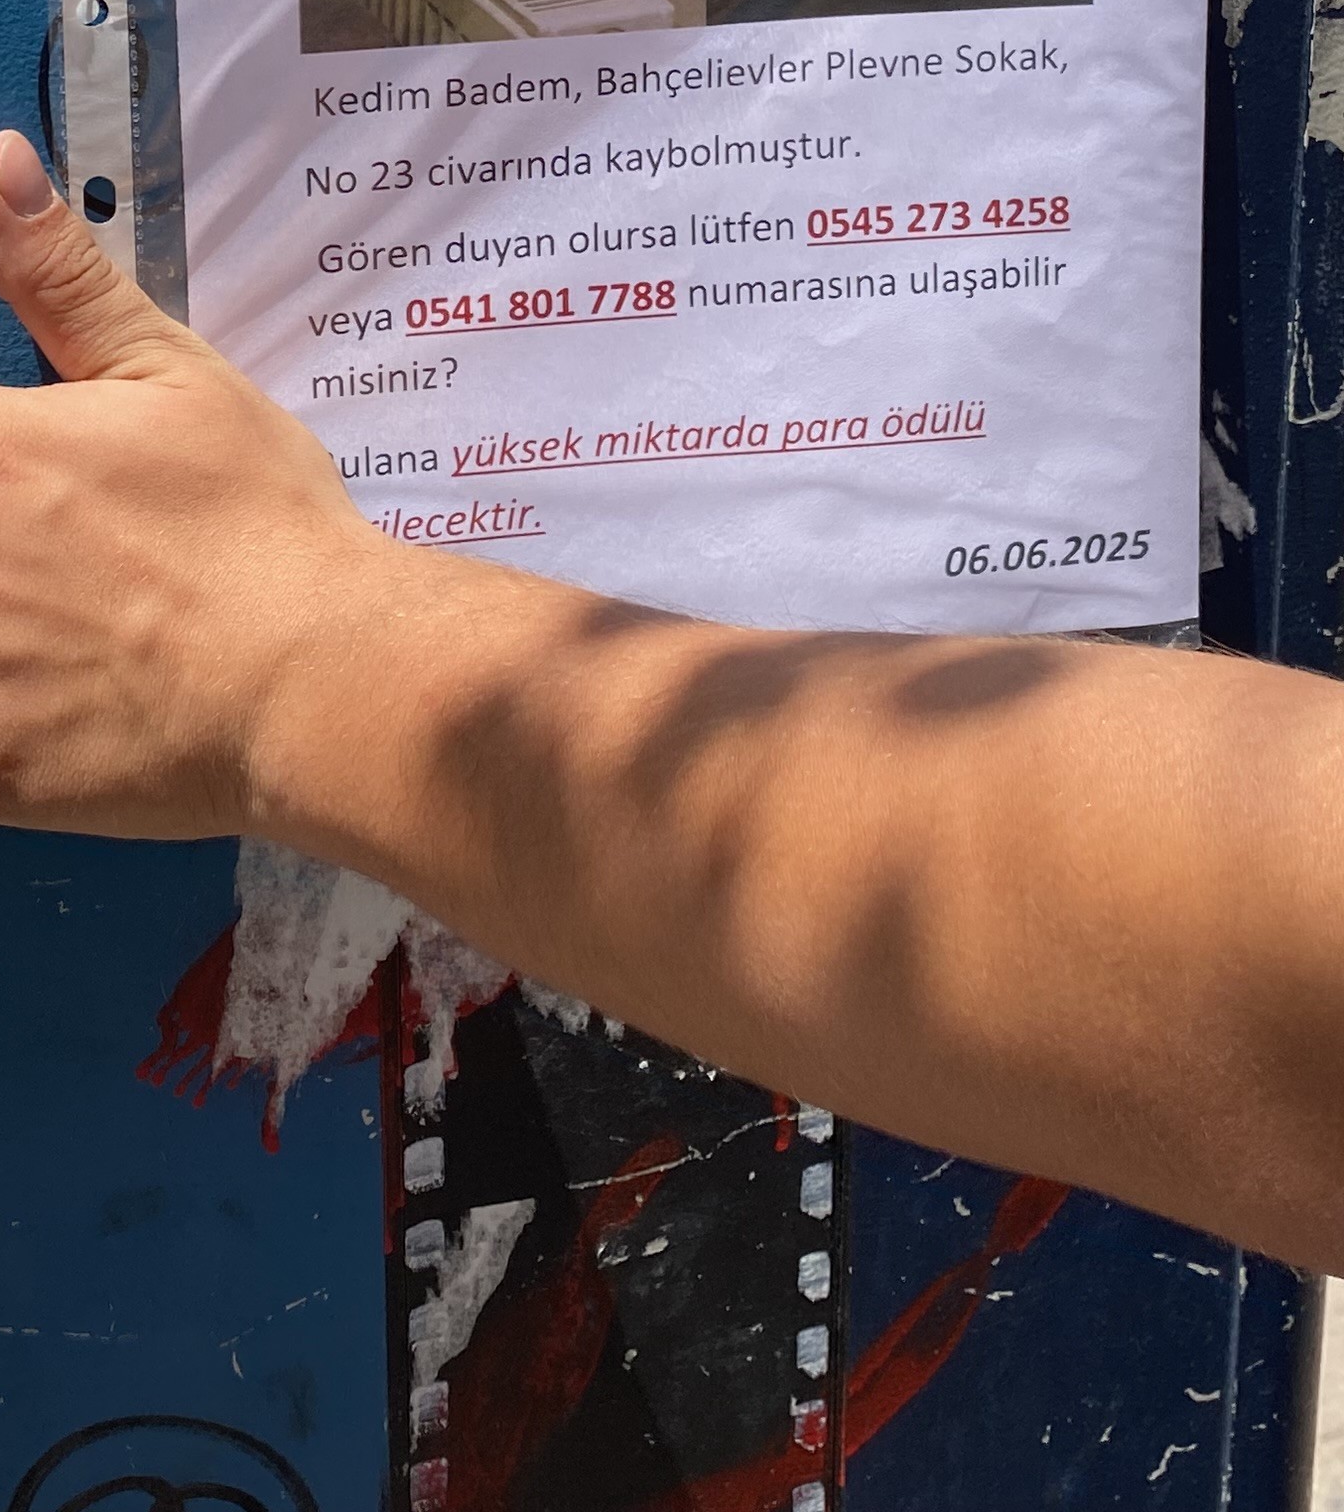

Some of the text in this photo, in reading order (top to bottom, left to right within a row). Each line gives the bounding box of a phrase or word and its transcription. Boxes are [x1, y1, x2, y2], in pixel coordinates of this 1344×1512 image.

[315, 38, 1068, 117] Kedim Badem, Bahçelievler Plevne Sokak,
[305, 132, 861, 198] No 23 civarında kaybolmuştur.
[317, 195, 1070, 274] Gören duyan olursa lütfen 0545 273 4258
[307, 255, 1067, 342] veya 0541 801 7788 numarasına ulaşabilir
[312, 356, 458, 399] misiniz?
[328, 399, 986, 479] ulana yüksek miktarda para ödülü
[944, 528, 1151, 578] 06.06.2025
